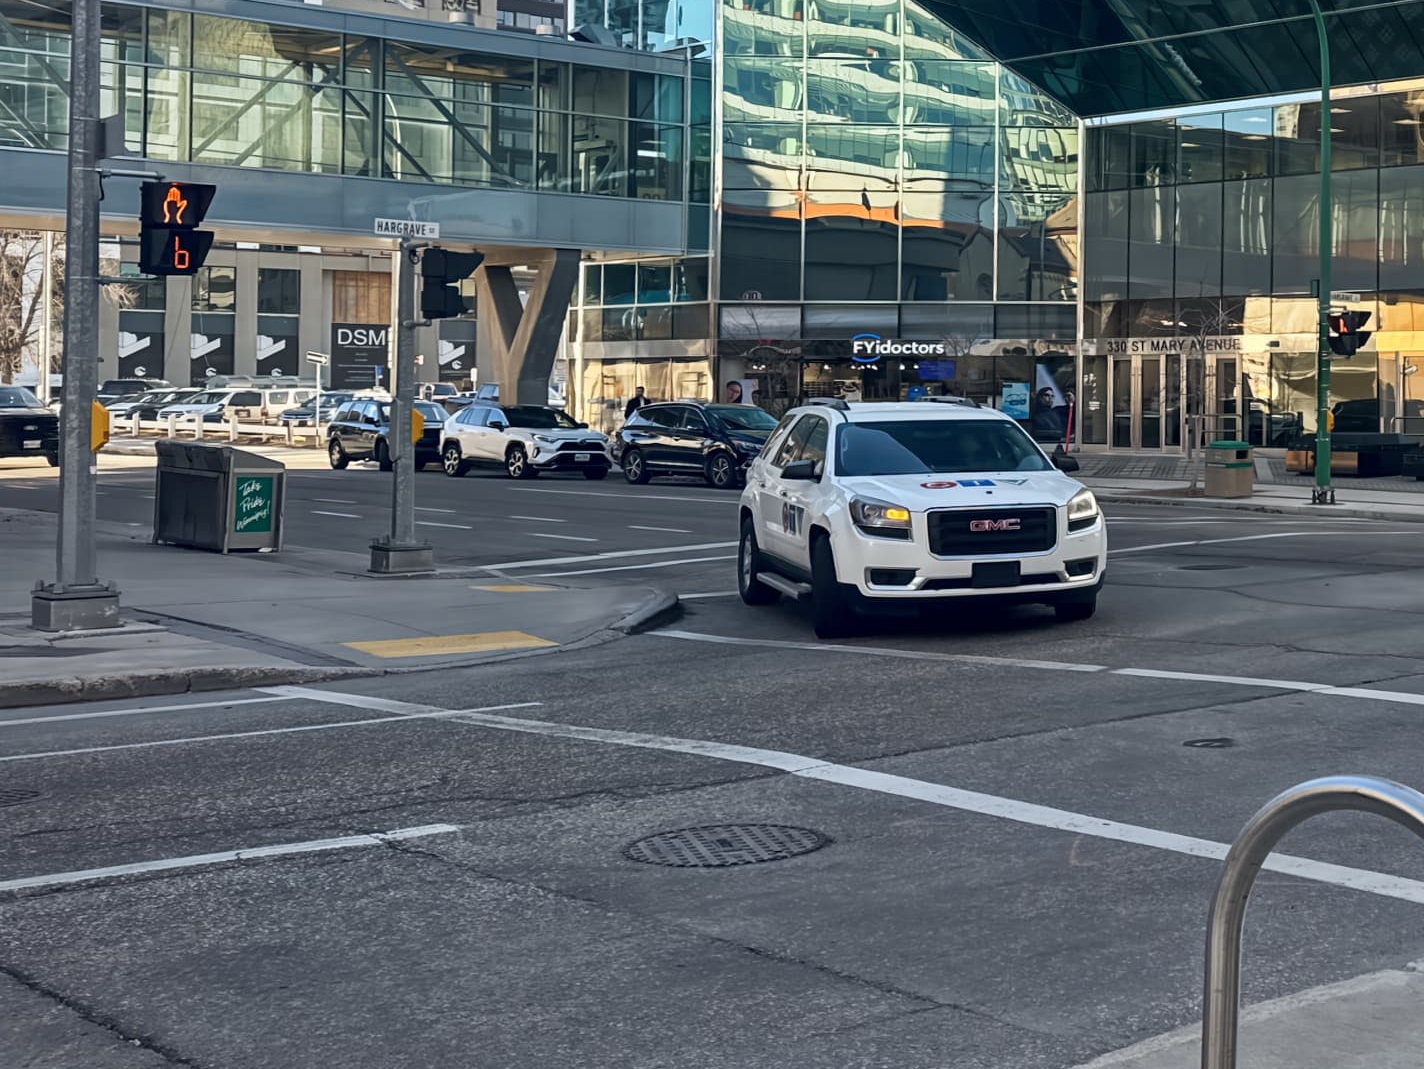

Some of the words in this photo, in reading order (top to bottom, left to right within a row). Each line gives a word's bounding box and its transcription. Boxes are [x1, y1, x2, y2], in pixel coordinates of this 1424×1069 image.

[377, 221, 426, 236] HARGRAVE
[338, 328, 386, 345] DSM
[853, 340, 945, 354] FYidoctors
[1107, 340, 1127, 353] 330
[1132, 340, 1146, 352] ST
[1150, 339, 1185, 352] MARY
[1189, 338, 1241, 352] AVENUE
[240, 496, 265, 513] Pride
[970, 518, 1021, 532] GMC
